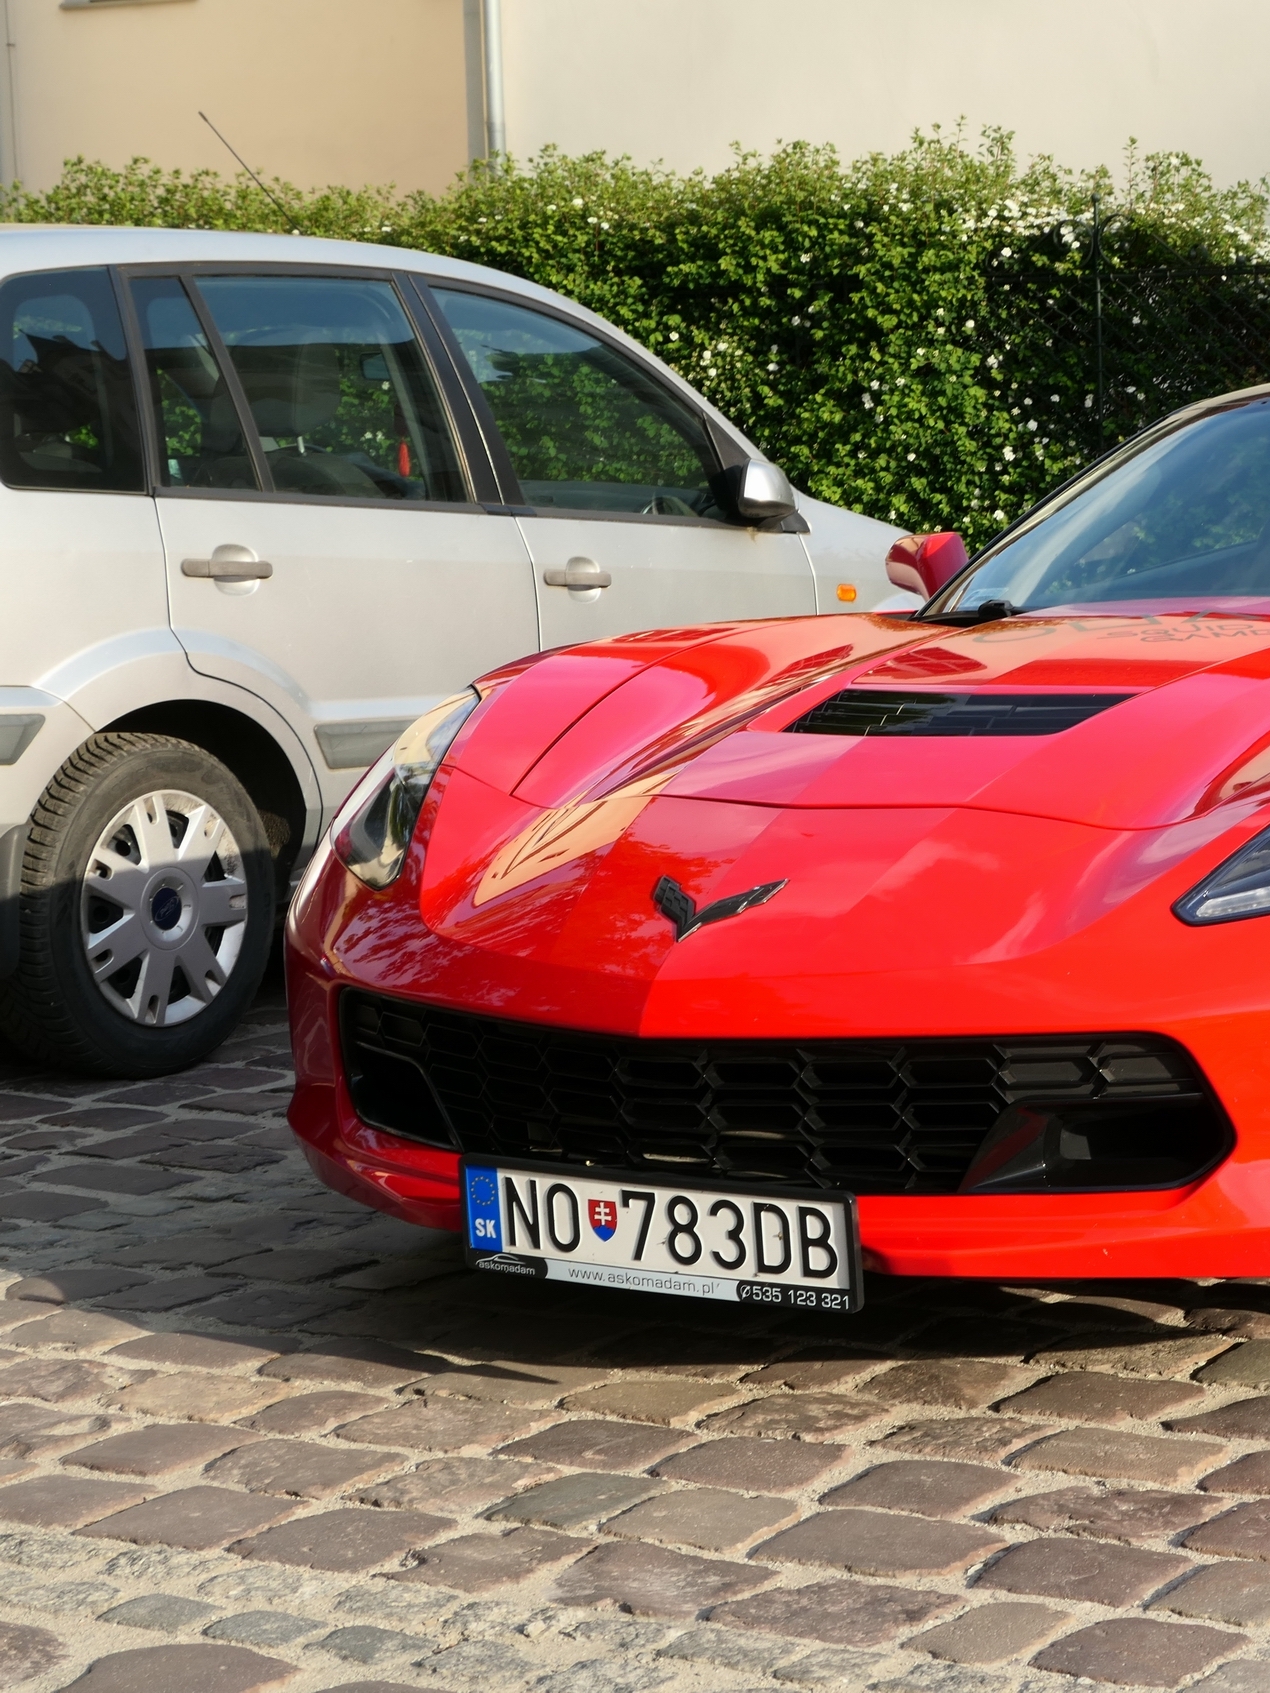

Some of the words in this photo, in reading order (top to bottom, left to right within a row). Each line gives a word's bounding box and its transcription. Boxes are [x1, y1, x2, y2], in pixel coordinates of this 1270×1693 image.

[1097, 623, 1253, 639] SQUID
[474, 1218, 497, 1239] SK
[504, 1175, 581, 1253] NO
[620, 1189, 838, 1279] 783DB
[477, 1260, 536, 1276] askomadam
[568, 1267, 715, 1296] www.askomadam.pl
[752, 1286, 782, 1304] 535
[788, 1289, 817, 1306] 123
[821, 1292, 850, 1310] 321
